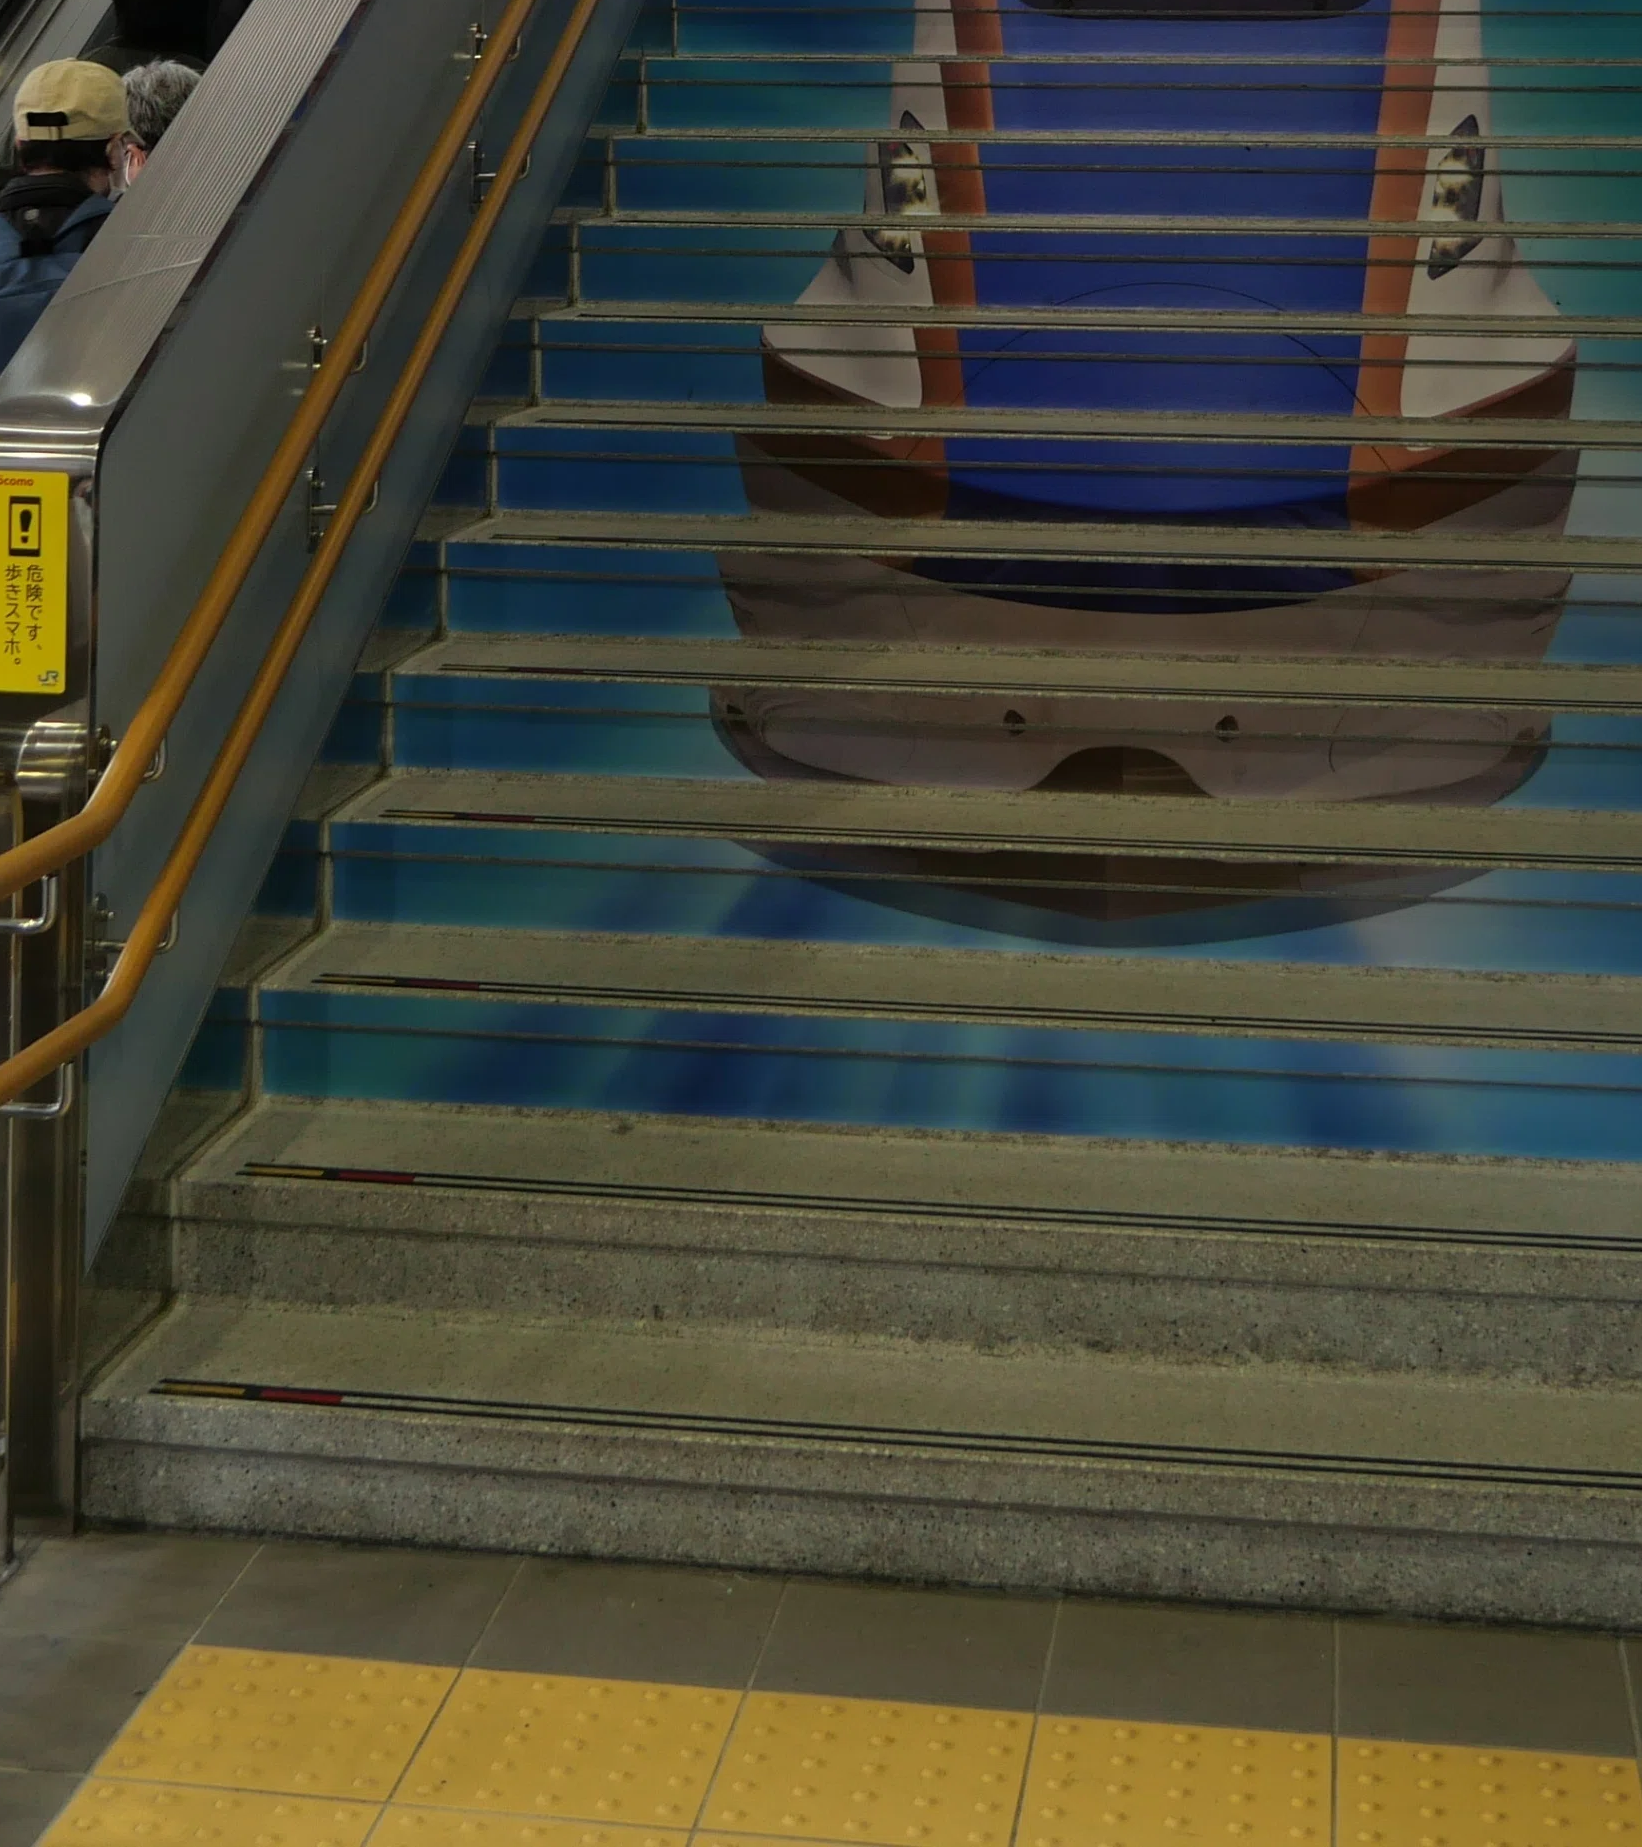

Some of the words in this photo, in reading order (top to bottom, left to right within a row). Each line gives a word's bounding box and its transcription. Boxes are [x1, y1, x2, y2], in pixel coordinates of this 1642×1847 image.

[4, 564, 23, 665] 歩きスマホ。
[26, 564, 44, 650] 危険です、
